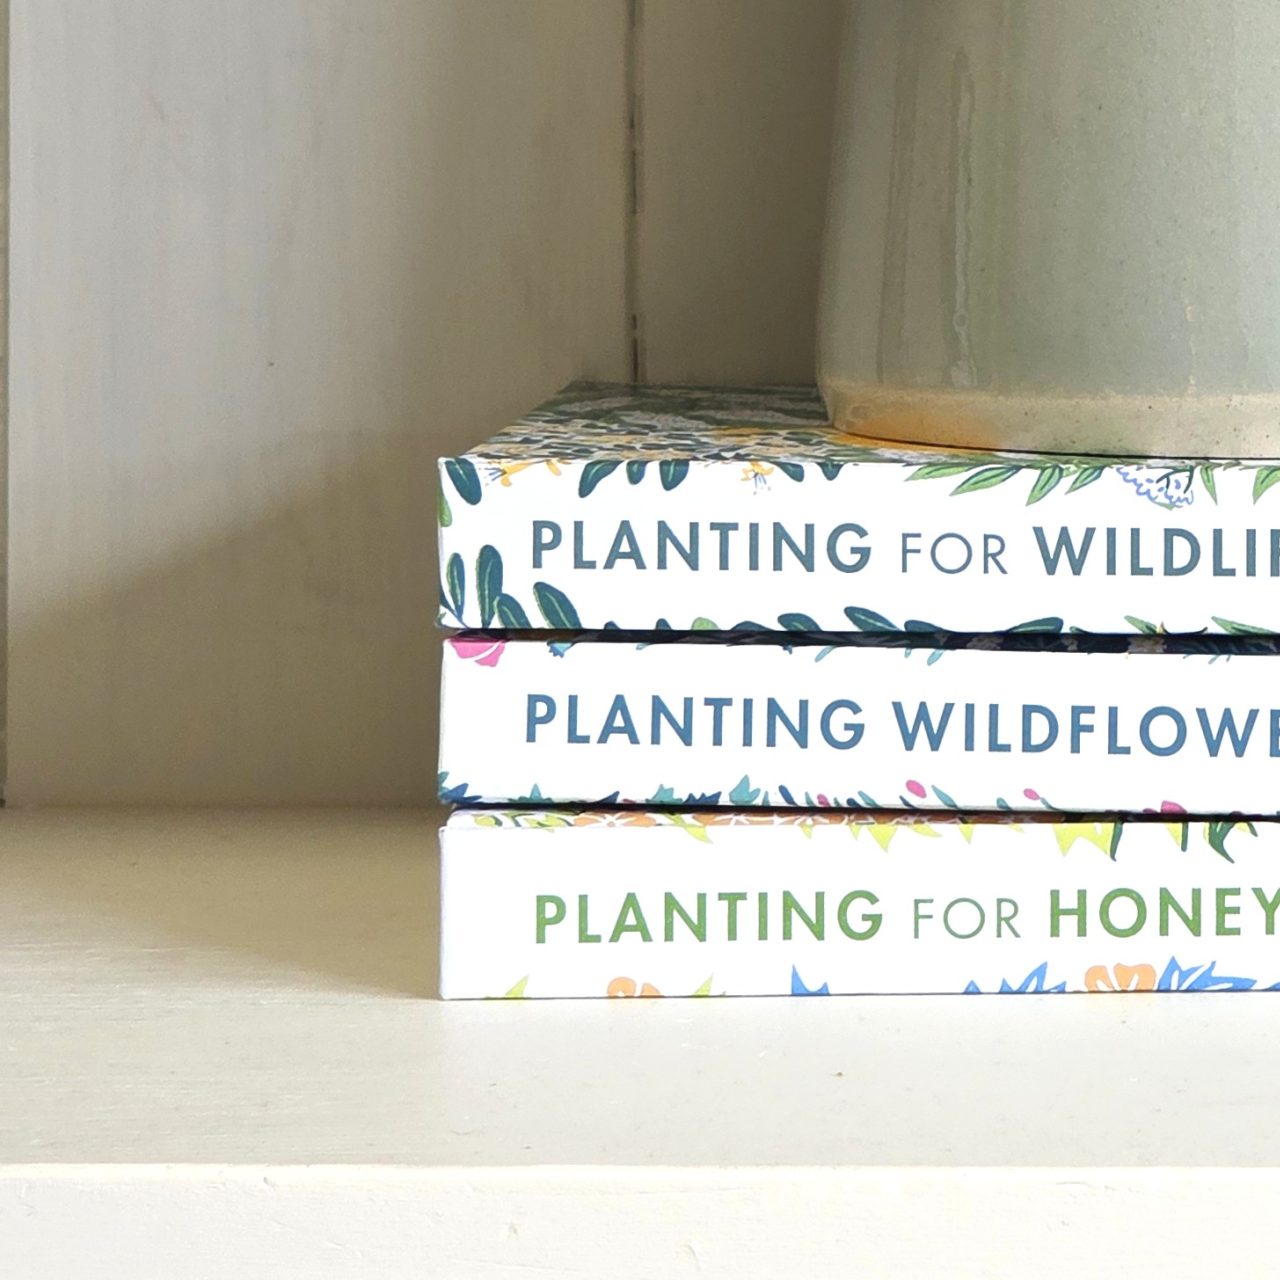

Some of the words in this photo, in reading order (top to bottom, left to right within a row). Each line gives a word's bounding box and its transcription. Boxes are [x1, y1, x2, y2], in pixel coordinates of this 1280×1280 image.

[532, 519, 872, 574] PLANTING
[901, 532, 1009, 575] FOR
[525, 693, 866, 751] PLANTING
[535, 889, 883, 945] PLANTING
[913, 897, 1021, 940] FOR
